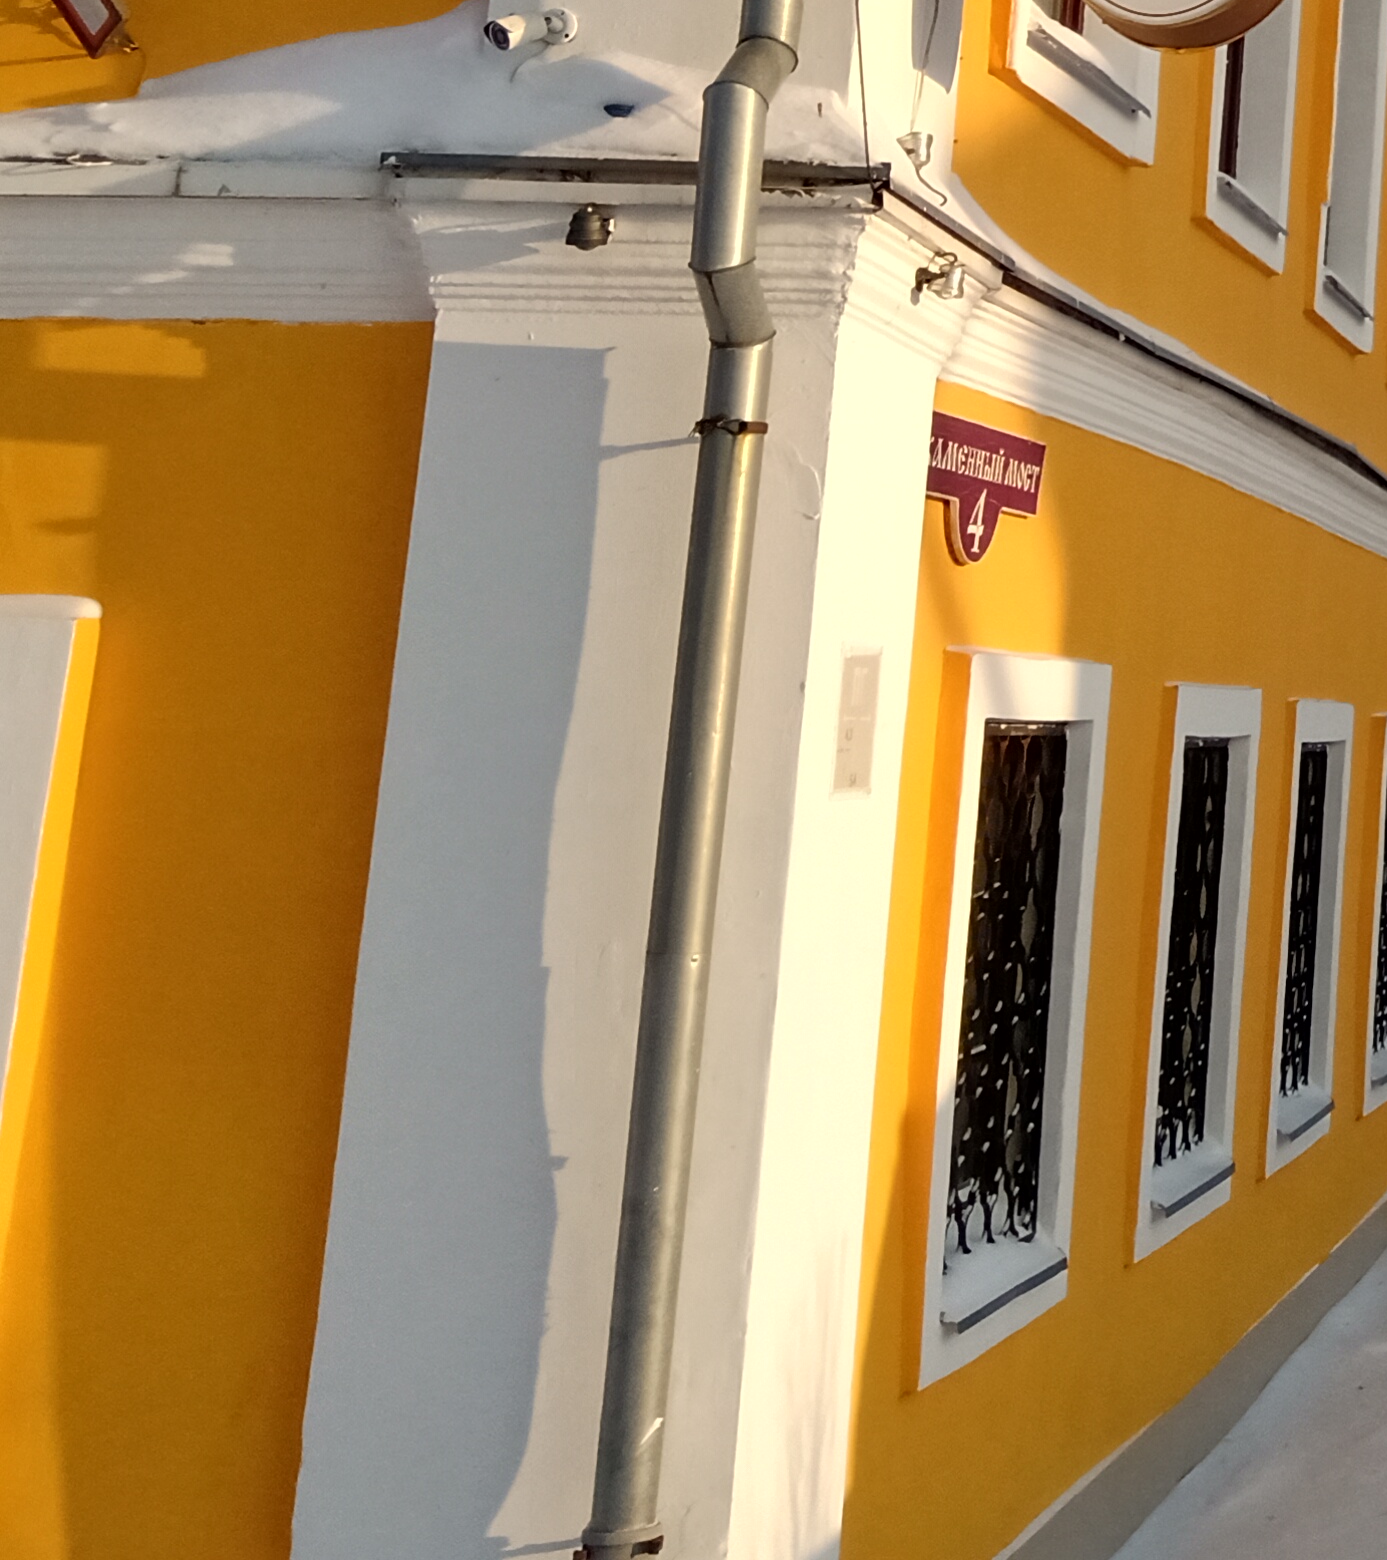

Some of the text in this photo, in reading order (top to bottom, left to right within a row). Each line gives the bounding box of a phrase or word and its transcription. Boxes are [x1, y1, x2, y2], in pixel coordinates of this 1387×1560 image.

[930, 435, 1040, 494] АМЕННЫЙ МОСТ
[966, 488, 988, 553] 4
